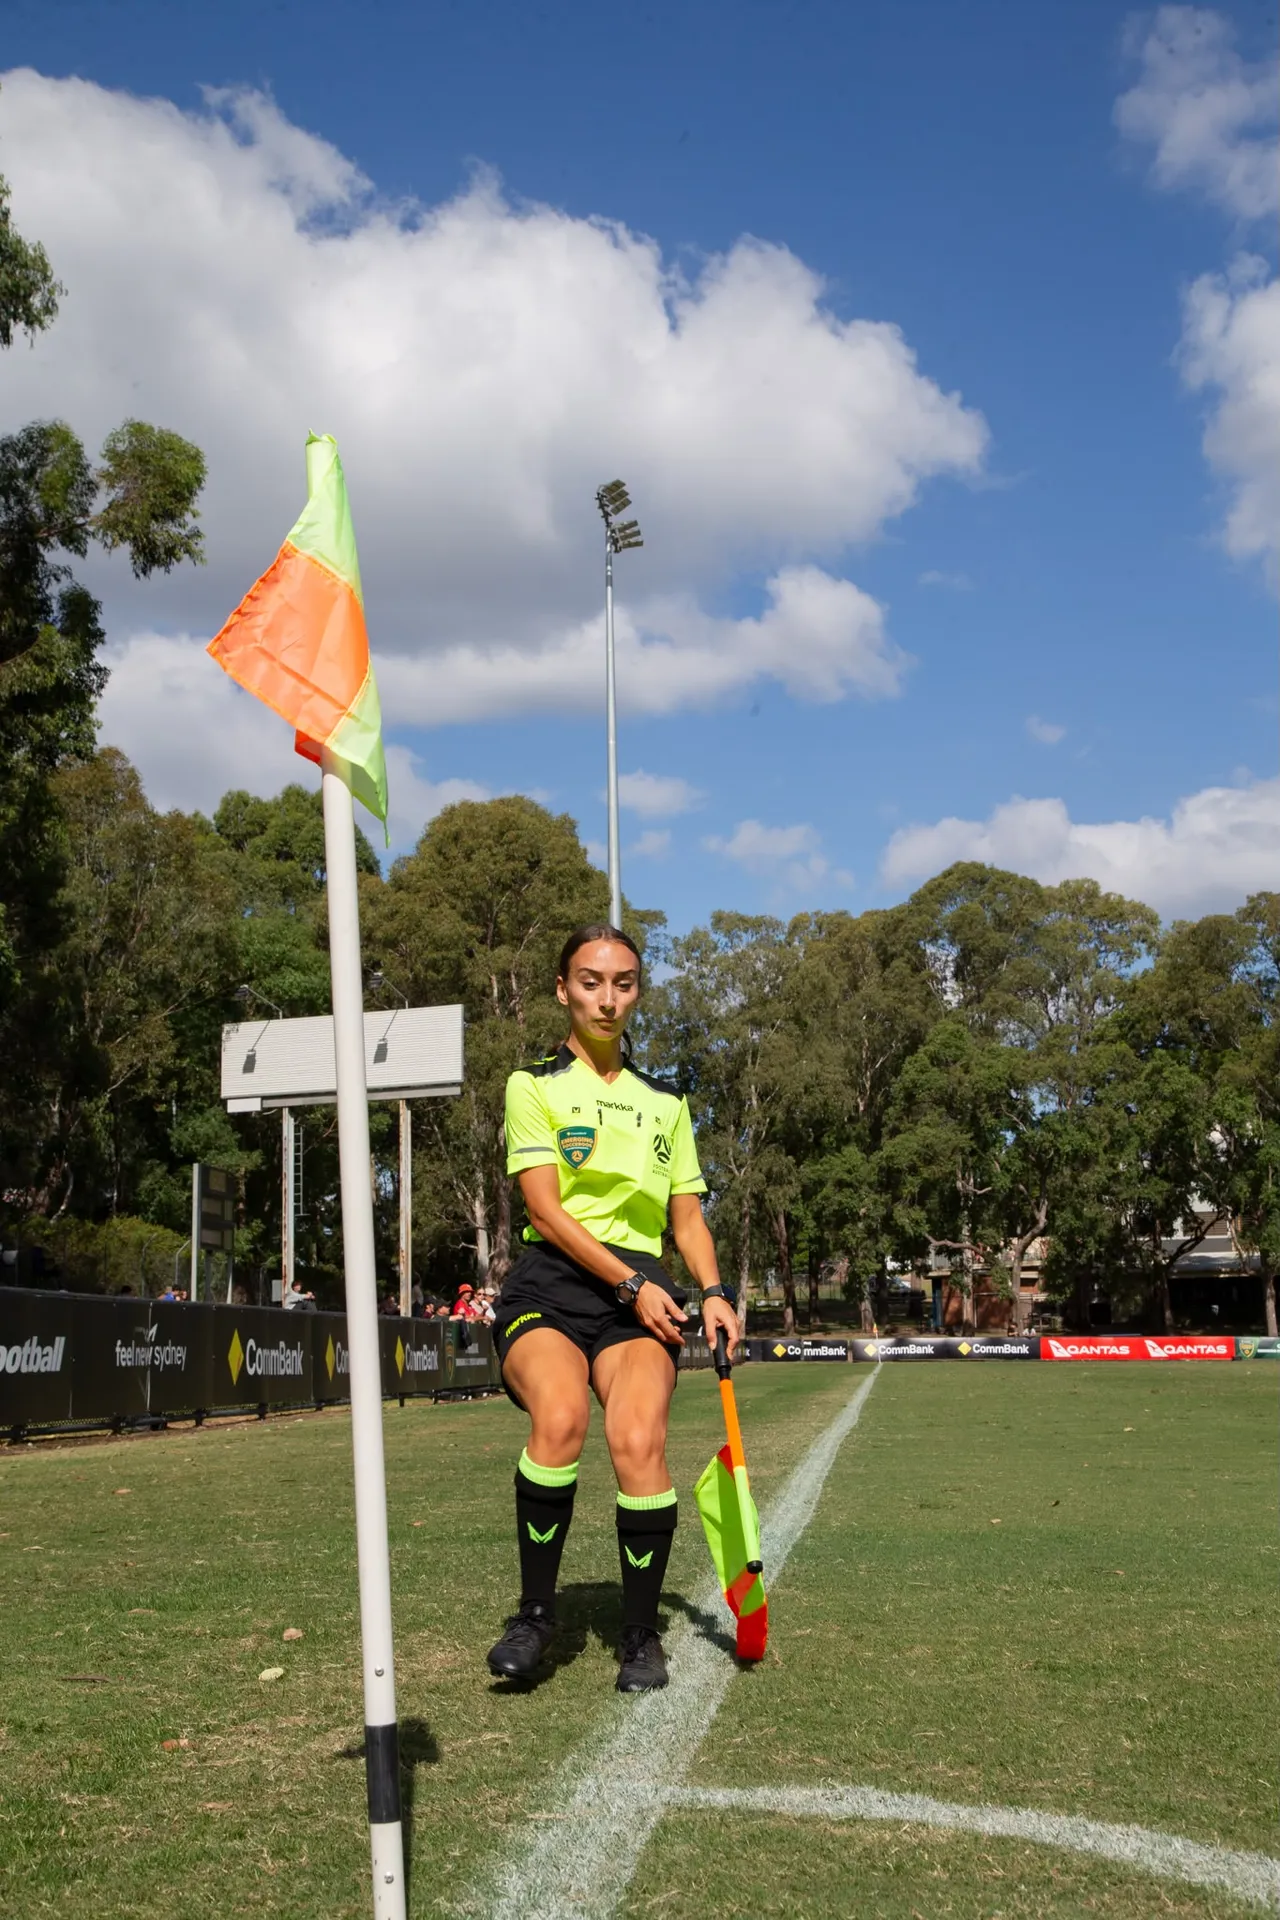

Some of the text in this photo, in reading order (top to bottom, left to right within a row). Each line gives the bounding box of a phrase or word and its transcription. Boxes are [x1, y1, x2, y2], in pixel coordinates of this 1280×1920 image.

[596, 1099, 634, 1111] markka
[878, 1344, 935, 1355] CommBank
[972, 1343, 1030, 1354] CommBank
[1067, 1345, 1130, 1355] QANTAS
[1163, 1345, 1228, 1355] QANTAS
[115, 1339, 187, 1372] feel new sydney
[246, 1338, 304, 1376] CommBank
